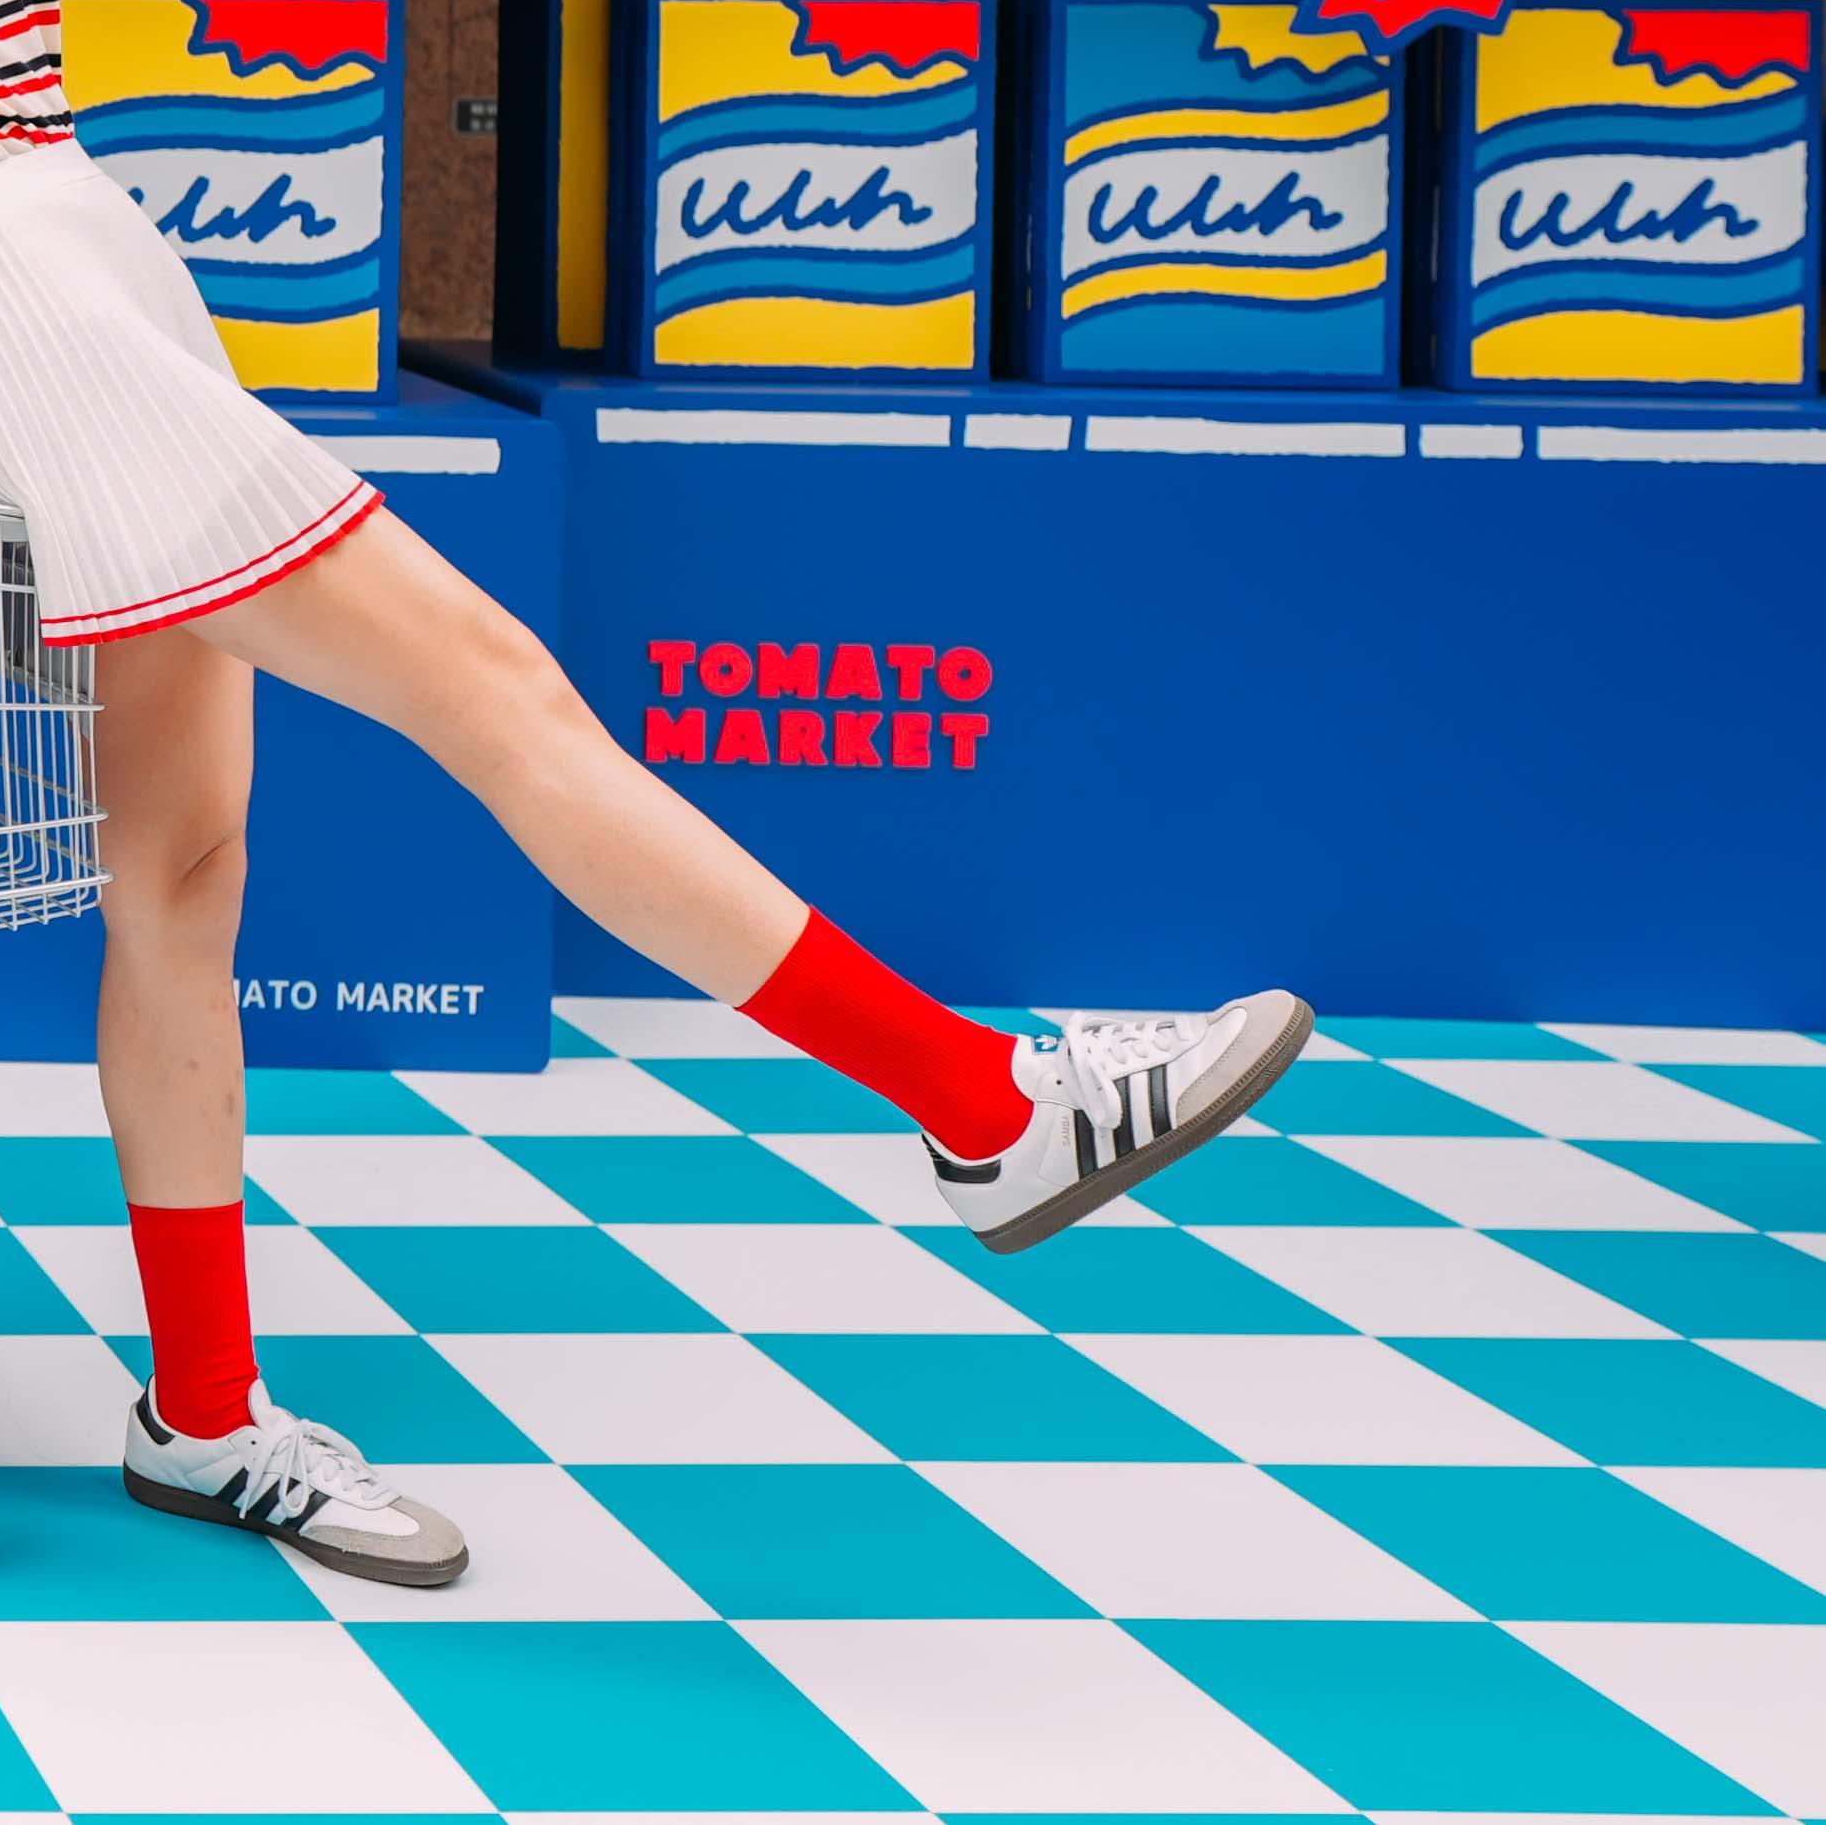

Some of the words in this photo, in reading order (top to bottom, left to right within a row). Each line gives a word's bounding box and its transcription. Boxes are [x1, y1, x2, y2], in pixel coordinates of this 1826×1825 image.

[647, 639, 994, 702] TOMATO
[643, 706, 990, 770] MARKET
[233, 978, 318, 1011] ATO
[336, 981, 485, 1016] MARKET
